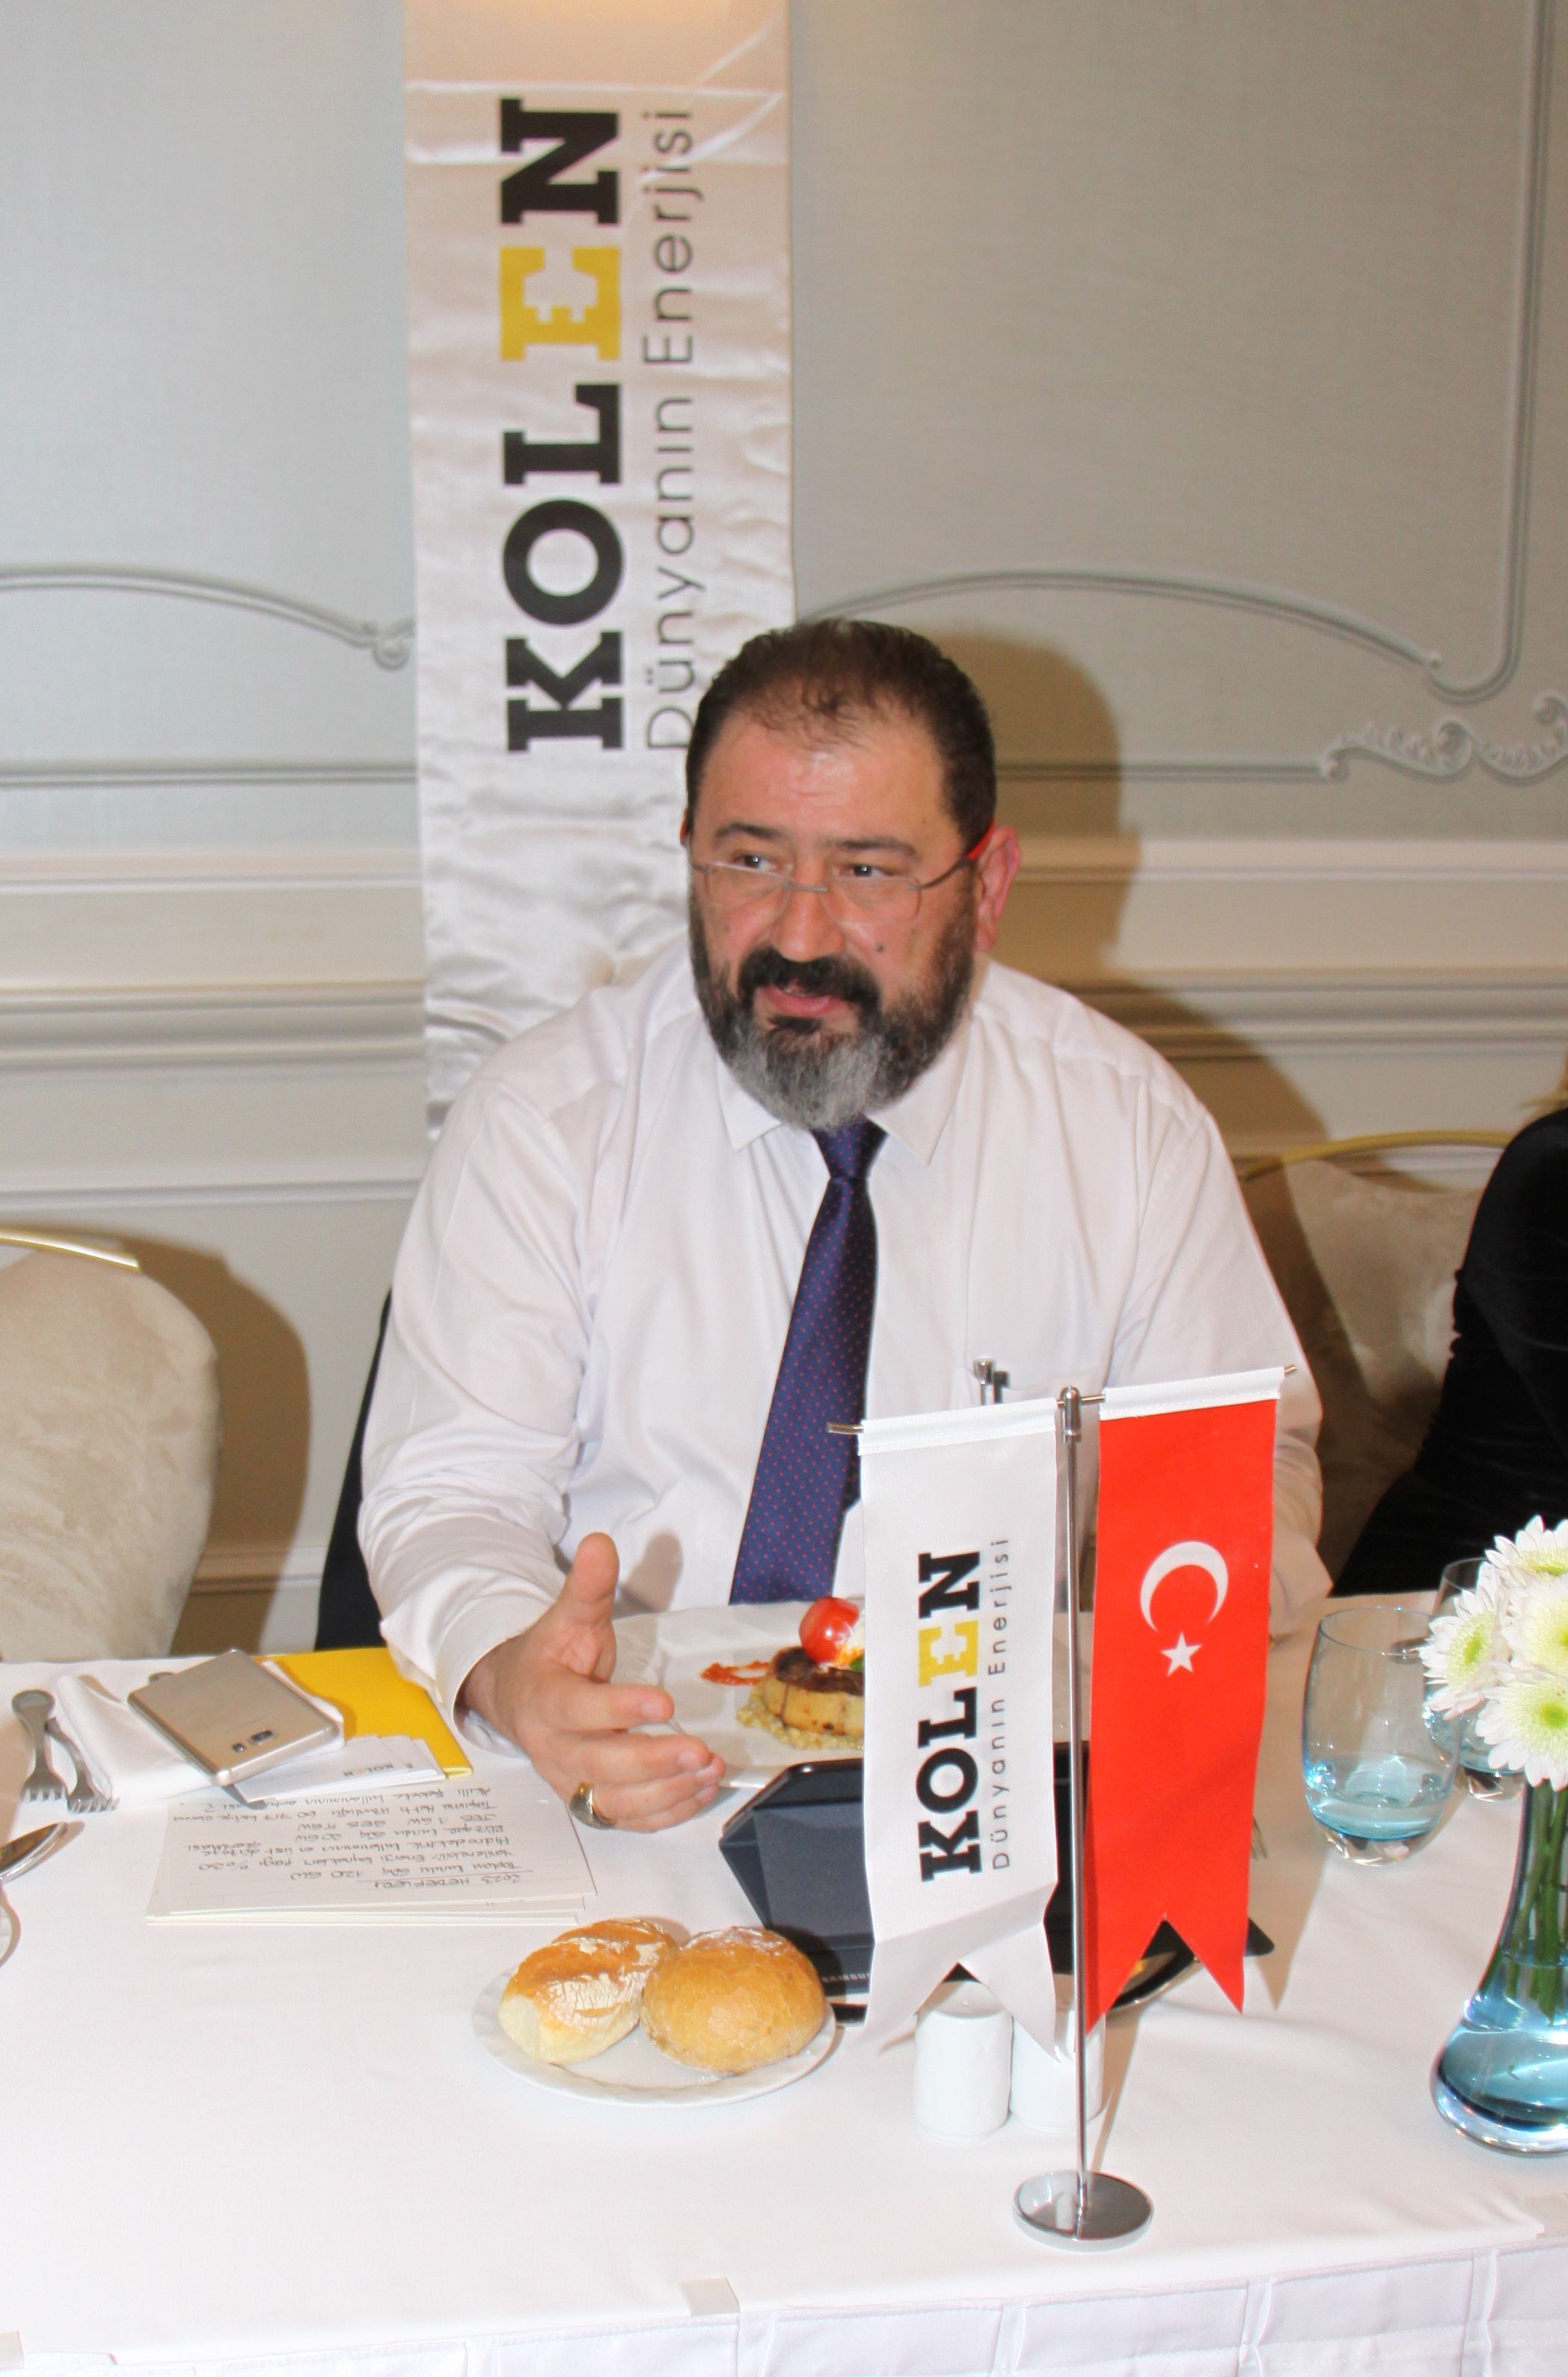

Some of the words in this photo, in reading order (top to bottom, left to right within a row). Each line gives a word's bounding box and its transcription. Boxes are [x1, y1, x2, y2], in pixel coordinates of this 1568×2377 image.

[642, 110, 704, 364] Enerjisi
[499, 97, 624, 752] KOLEN
[646, 395, 704, 750] Dünyanın
[916, 1550, 981, 1882] KOLEN
[988, 1538, 1012, 1676] Enerjisi
[990, 1698, 1011, 1869] Dünyanın
